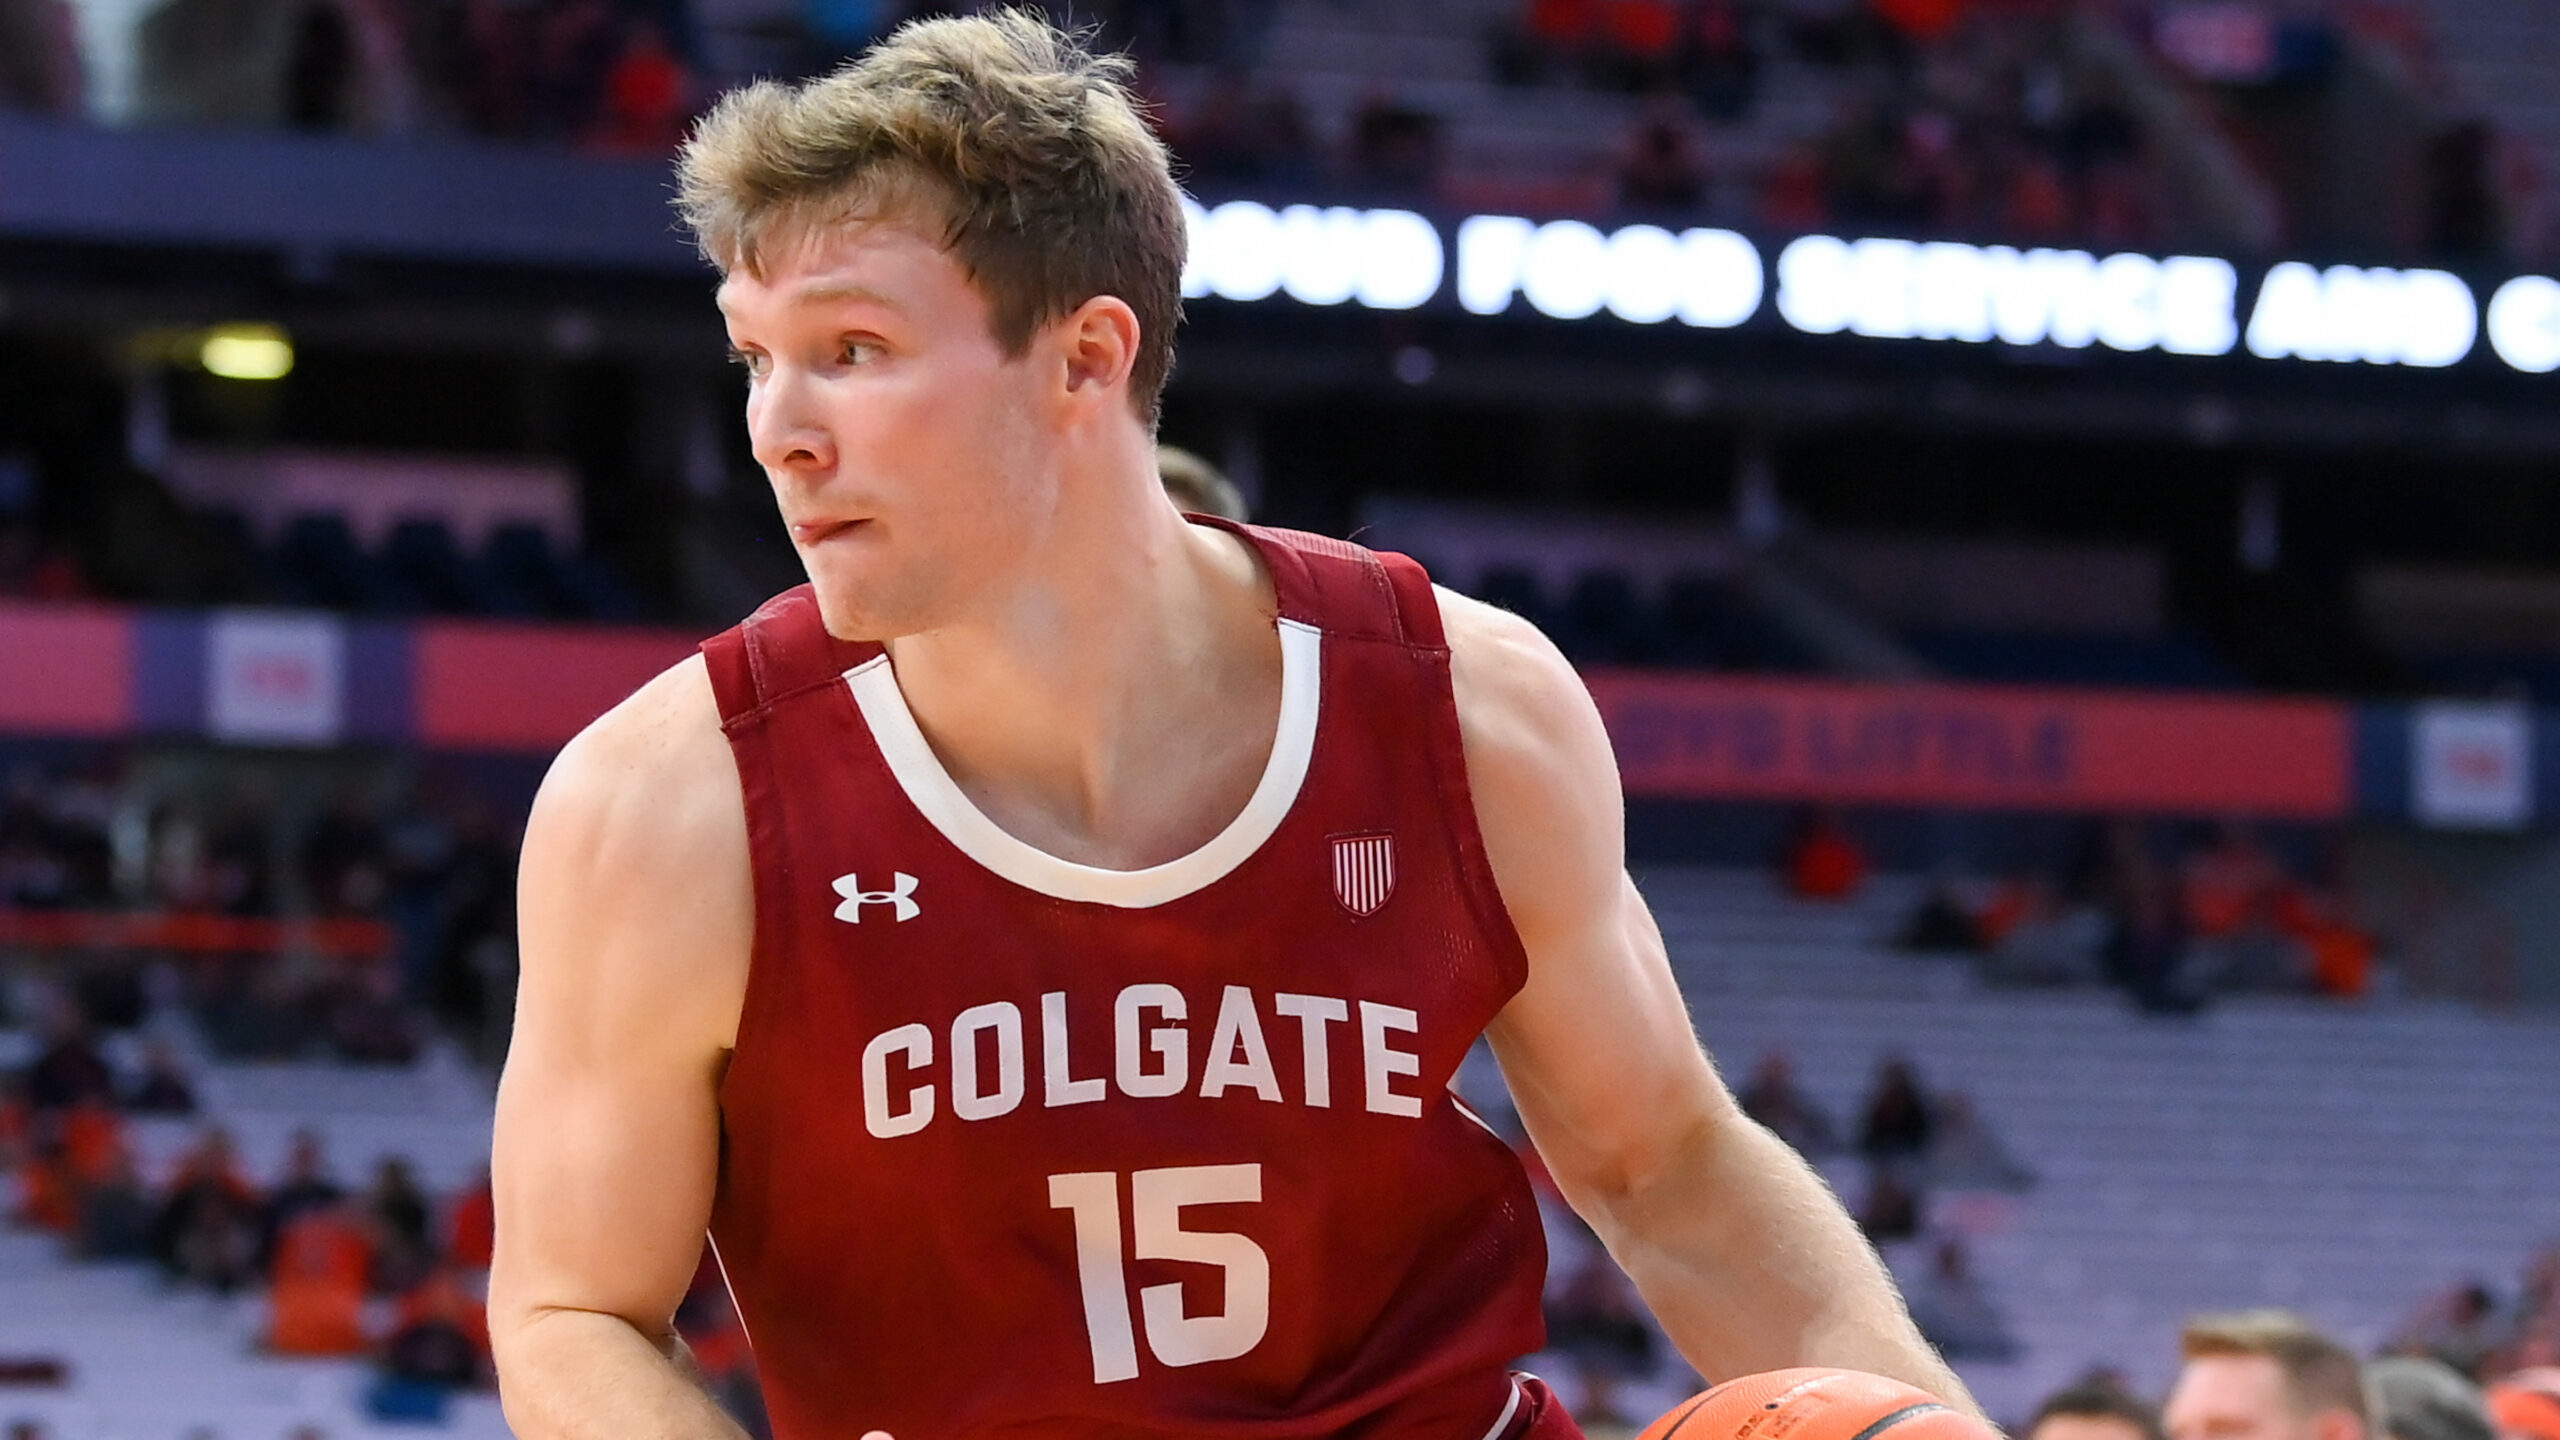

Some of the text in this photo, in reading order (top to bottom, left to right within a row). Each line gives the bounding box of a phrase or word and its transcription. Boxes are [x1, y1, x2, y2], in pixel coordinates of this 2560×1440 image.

[1458, 216, 1762, 327] FOOD
[1778, 235, 2236, 356] SERVICE
[2247, 262, 2477, 367] AND
[862, 983, 1423, 1139] COLGATE
[1048, 1163, 1270, 1384] 15
